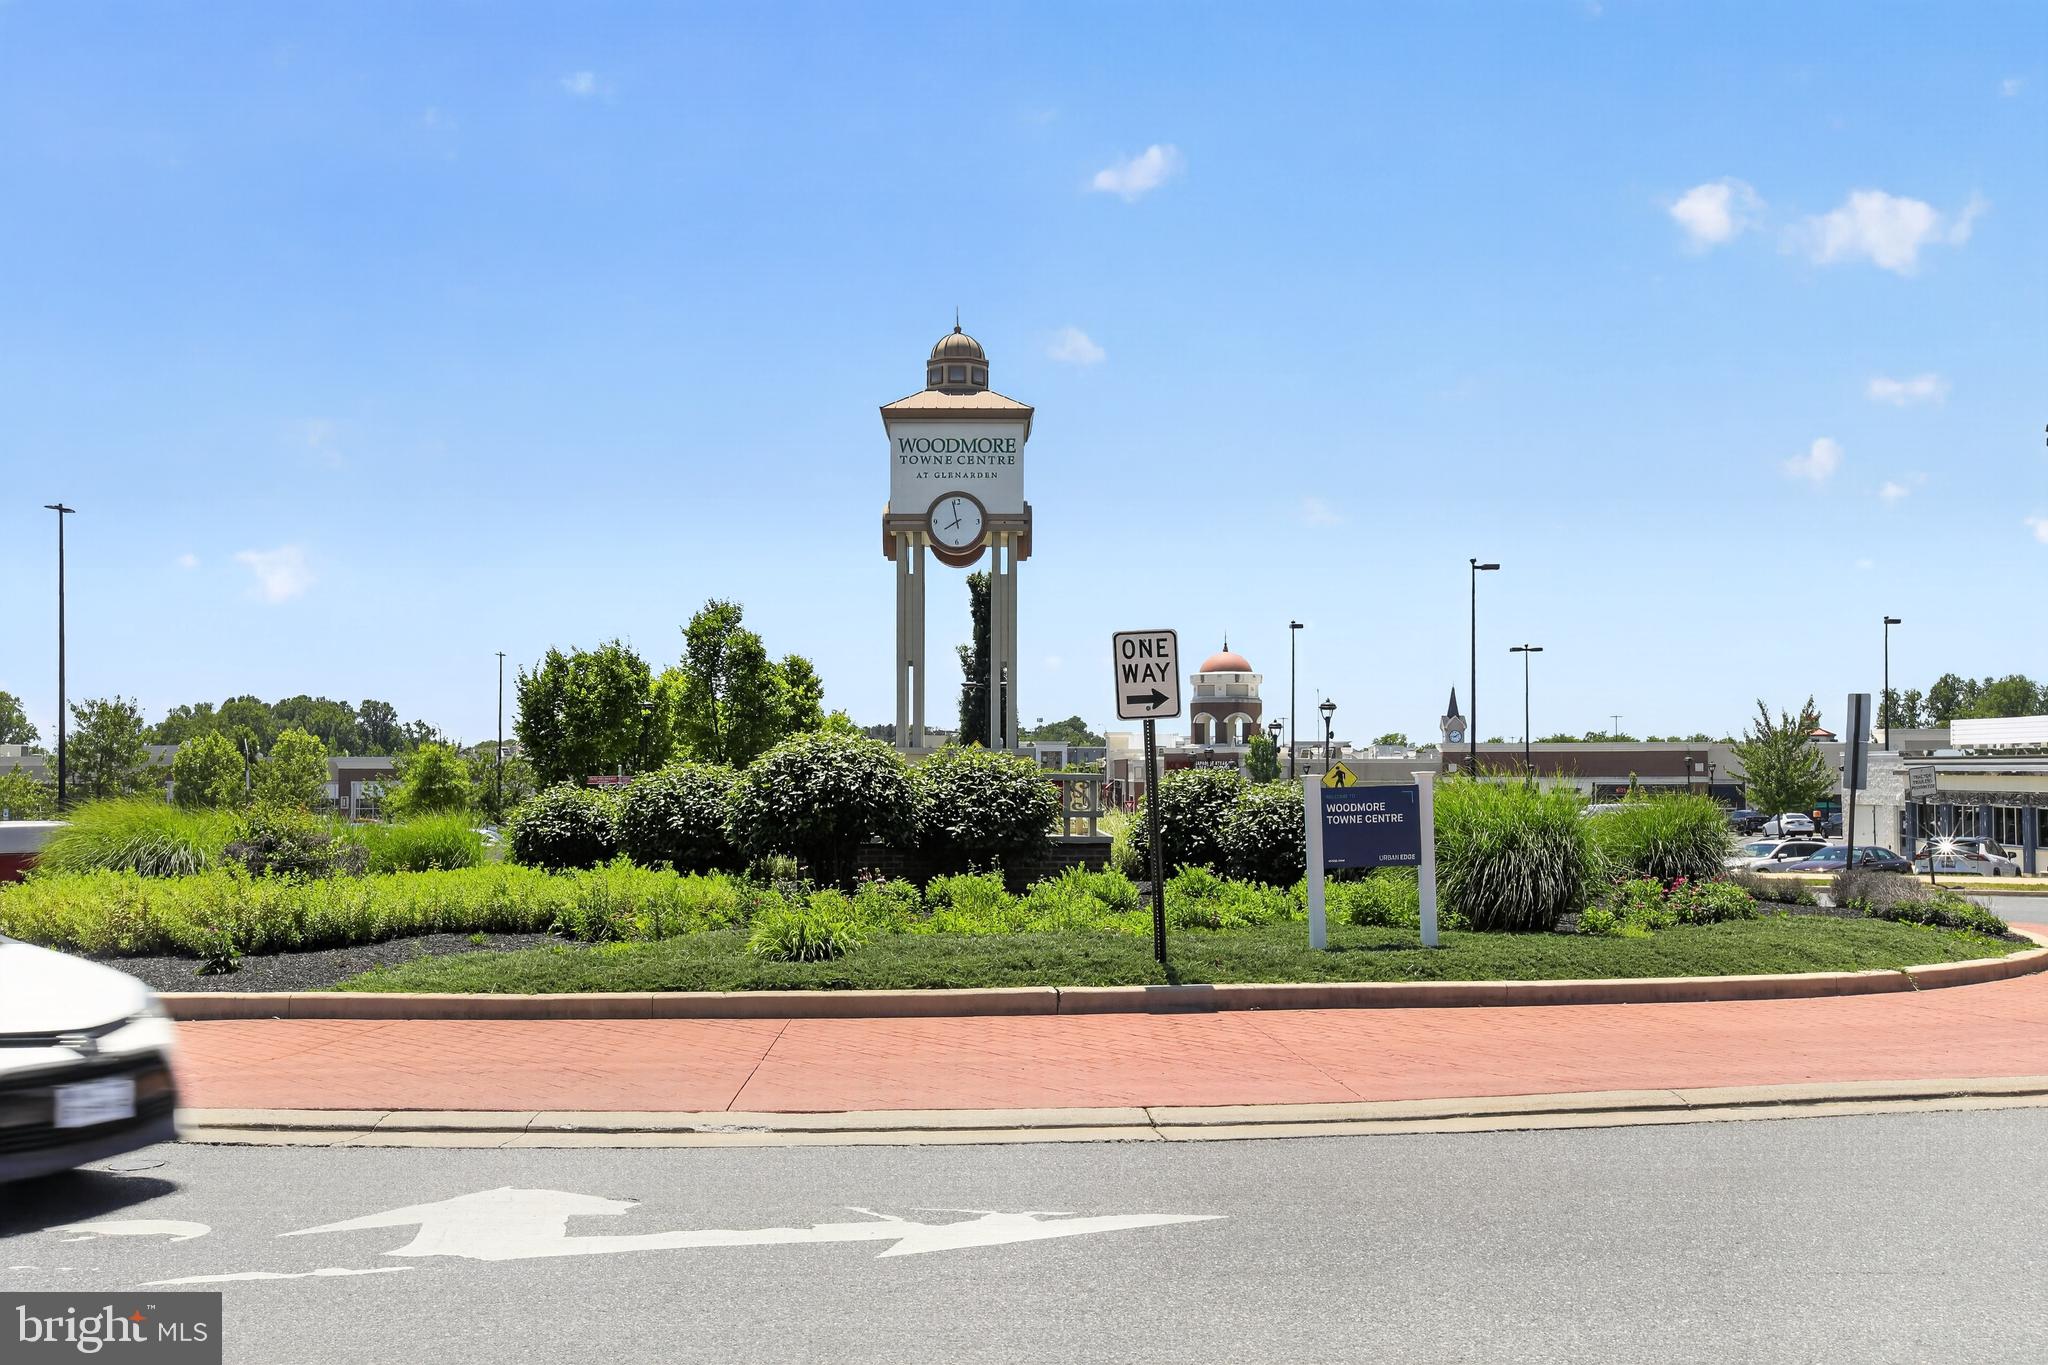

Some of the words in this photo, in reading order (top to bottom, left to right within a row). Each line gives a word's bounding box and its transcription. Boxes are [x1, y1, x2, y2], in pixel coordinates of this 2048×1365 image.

[898, 437, 1017, 454] WOODMORE
[899, 455, 953, 465] TOWNE
[956, 455, 1016, 465] CENTRE
[1122, 638, 1169, 660] ONE
[1122, 662, 1170, 684] WAY
[1326, 802, 1386, 813] WOODMORE
[1326, 814, 1363, 825] TOWNE
[1365, 813, 1404, 824] CENTRE
[1379, 854, 1399, 862] URBAN
[1400, 853, 1416, 861] EDGE
